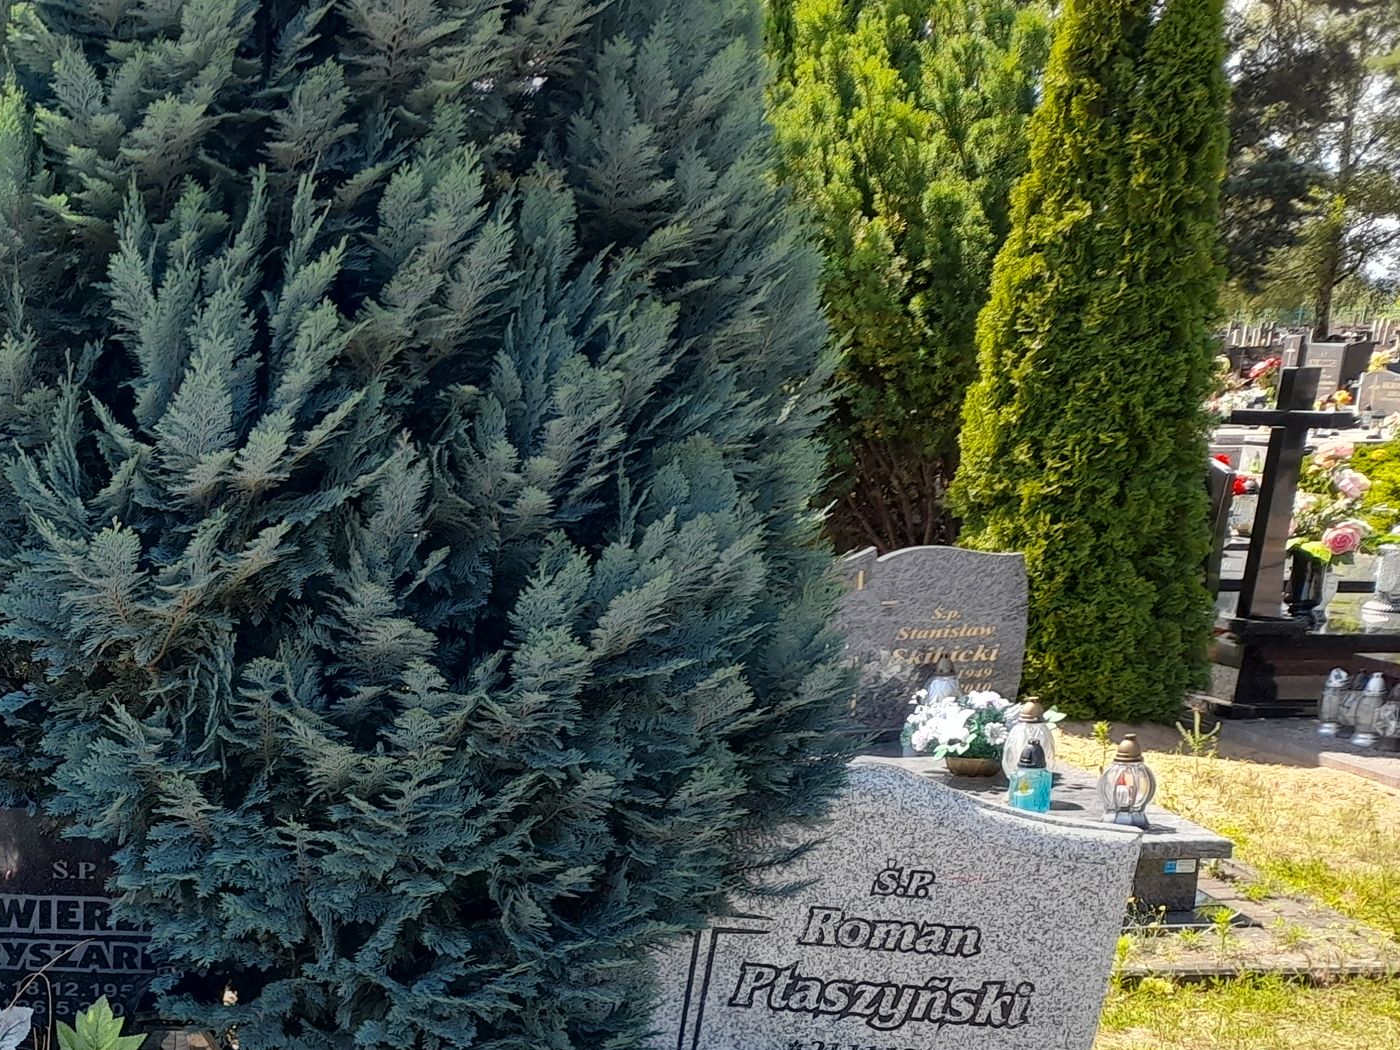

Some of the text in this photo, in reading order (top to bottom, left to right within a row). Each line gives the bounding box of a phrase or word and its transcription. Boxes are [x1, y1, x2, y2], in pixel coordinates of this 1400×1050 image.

[897, 624, 997, 641] Stanisław
[797, 905, 982, 958] Roman
[727, 960, 1036, 1031] Ptaszyński
